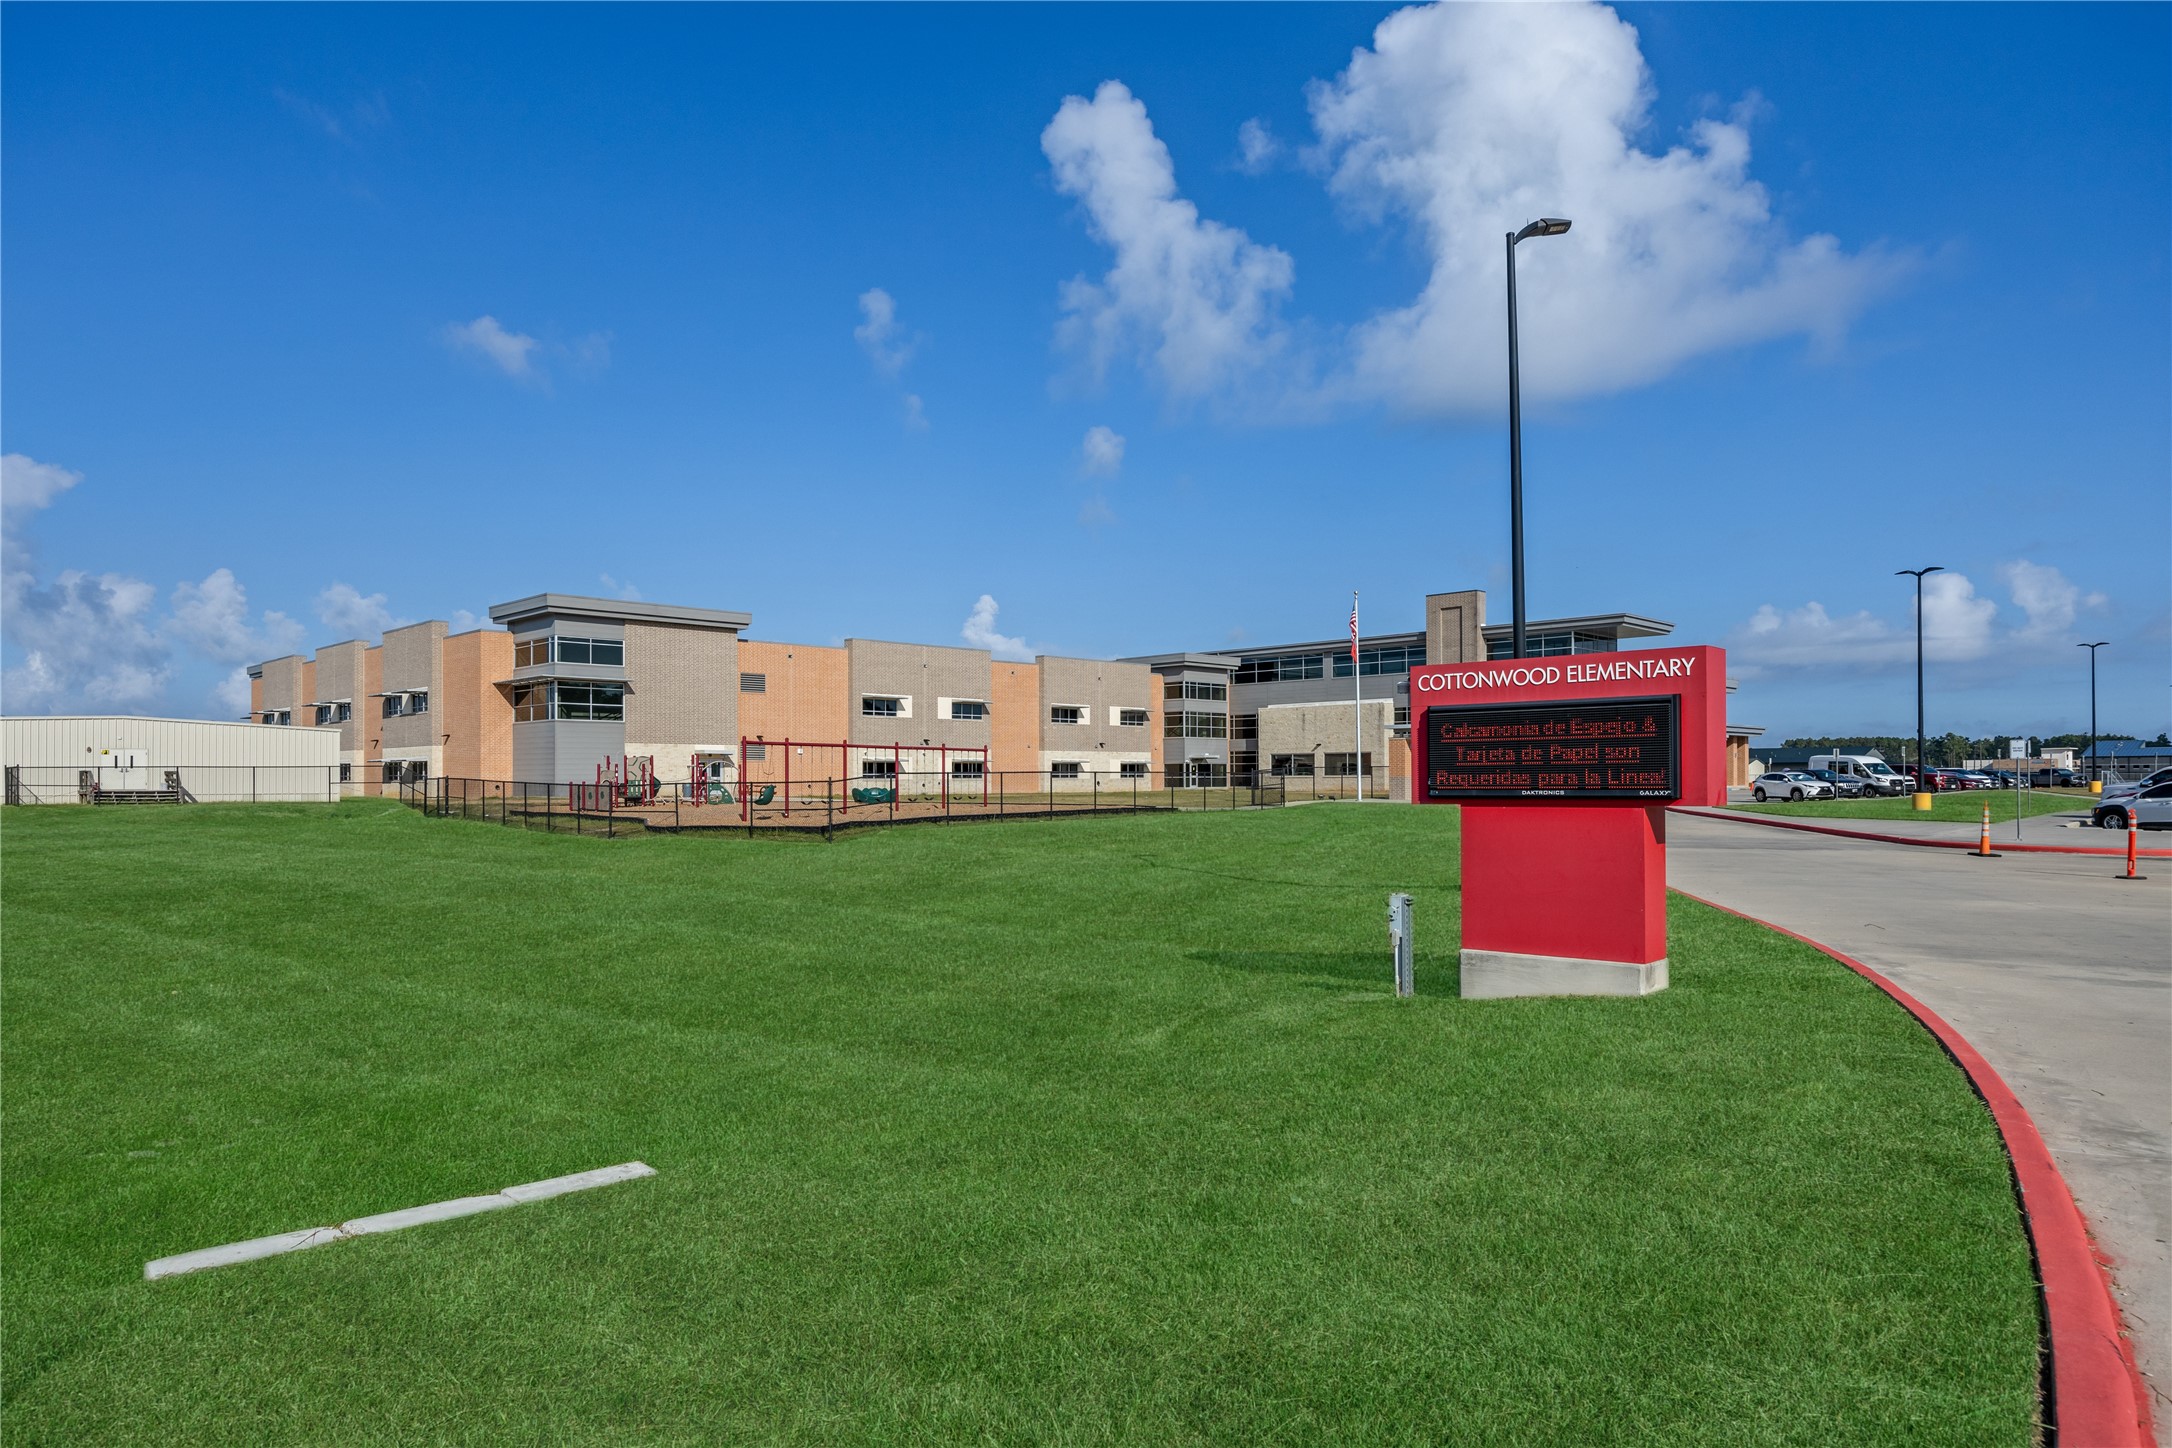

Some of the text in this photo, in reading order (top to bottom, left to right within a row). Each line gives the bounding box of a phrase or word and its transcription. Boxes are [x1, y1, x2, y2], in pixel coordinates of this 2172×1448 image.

[1418, 657, 1695, 692] COTTONWOOD ELEMENTARY
[1543, 720, 1566, 735] de
[1569, 717, 1637, 736] Espejo
[1456, 743, 1640, 763] Tarjeta de Papel son
[1436, 769, 1531, 787] Requeridas
[1538, 773, 1578, 788] para
[1585, 769, 1601, 784] la
